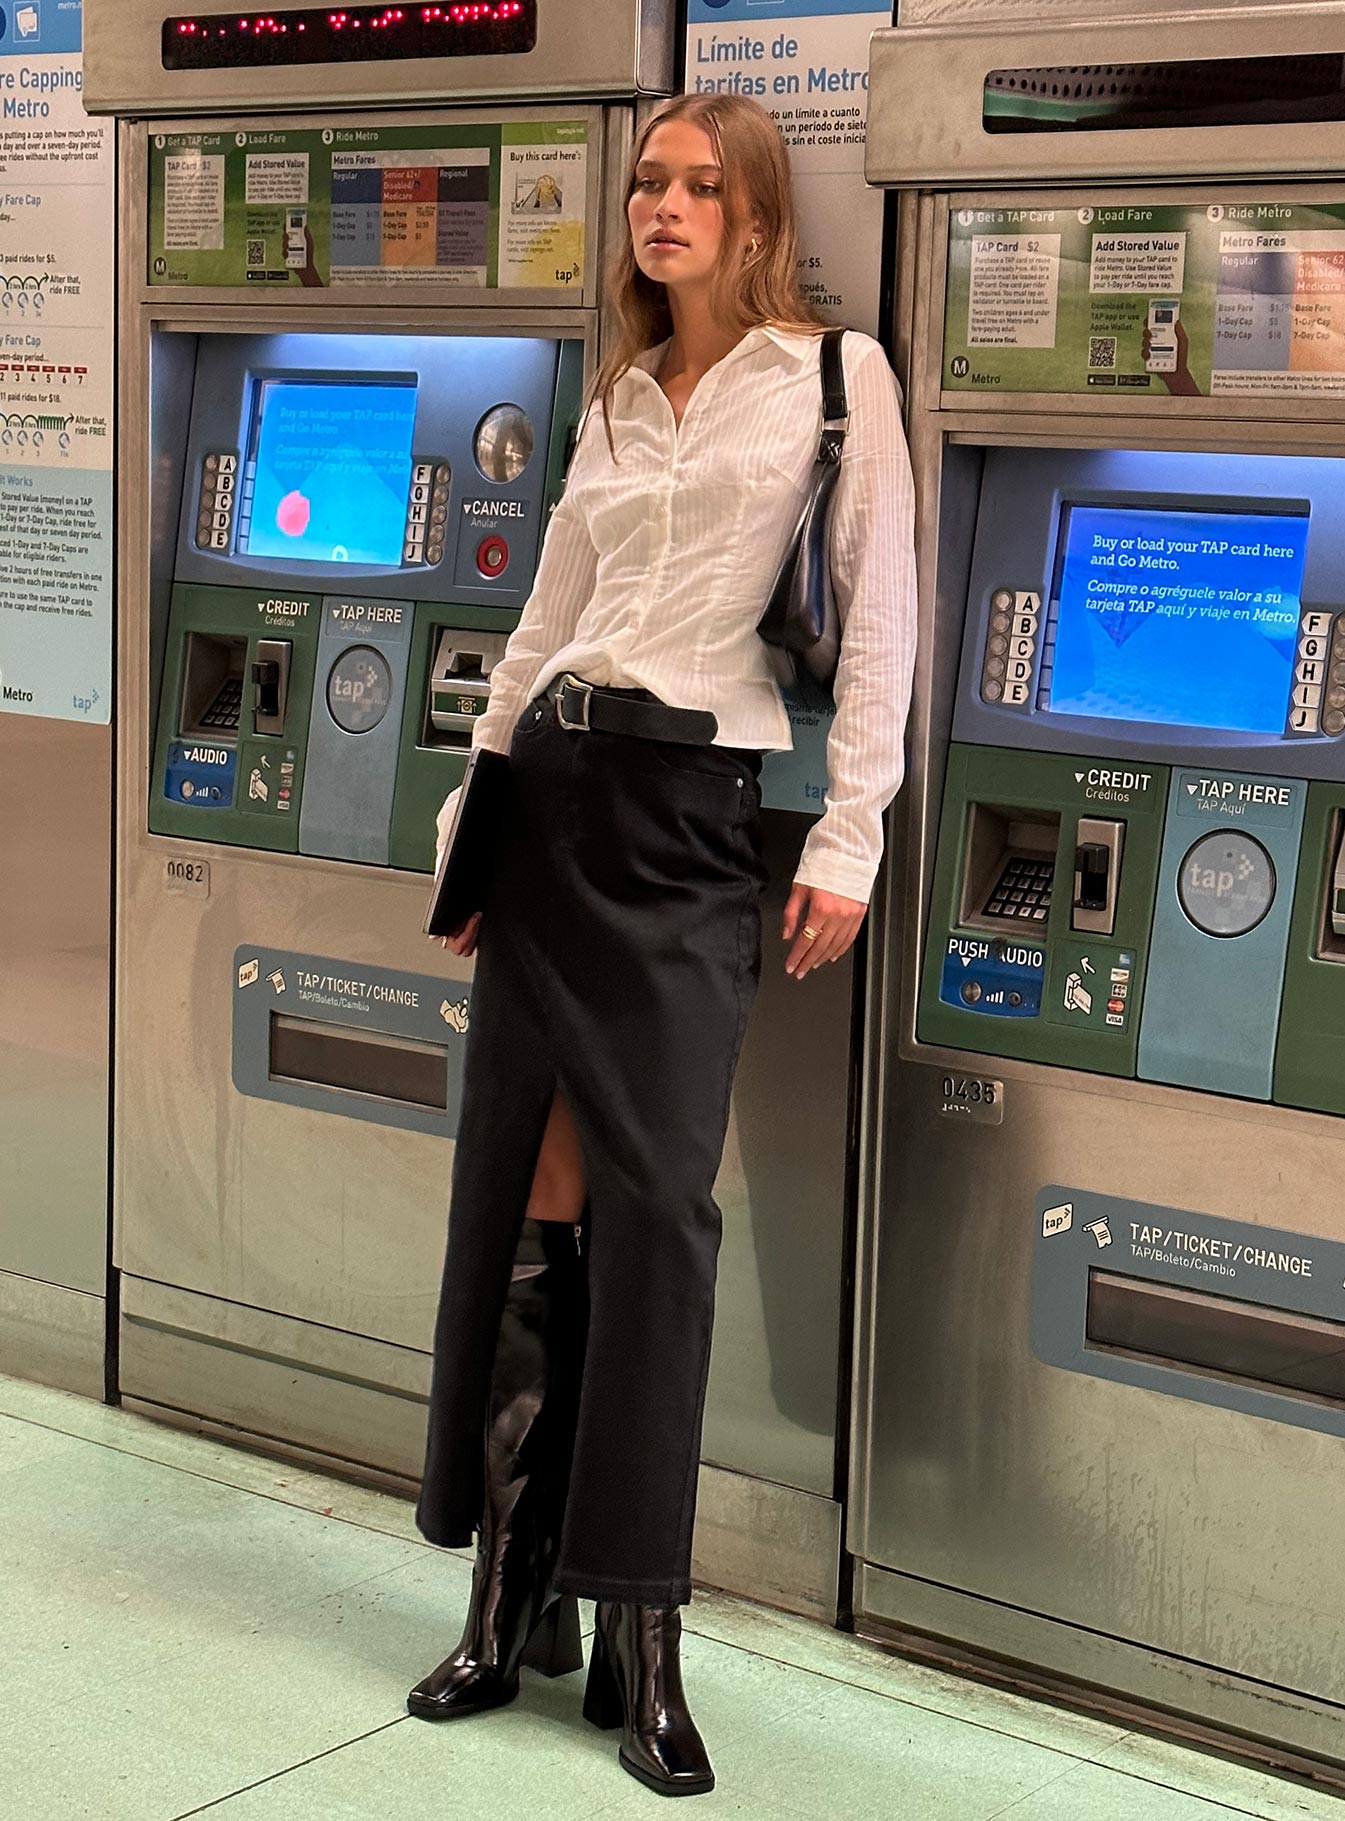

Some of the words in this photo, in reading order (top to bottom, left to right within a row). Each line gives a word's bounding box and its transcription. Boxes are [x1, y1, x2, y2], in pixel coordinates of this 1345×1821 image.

[697, 35, 764, 63] Límite
[771, 34, 798, 59] de
[19, 67, 82, 92] Capping
[696, 72, 766, 95] tarifas
[773, 75, 799, 95] en
[4, 98, 49, 118] Metro
[783, 111, 793, 119] un
[831, 108, 860, 117] cuanto
[786, 124, 796, 132] un
[834, 121, 845, 130] de
[168, 138, 180, 146] Get
[188, 137, 201, 145] TAP
[203, 136, 220, 145] Card
[249, 135, 267, 144] Load
[269, 134, 286, 143] Fare
[336, 132, 353, 141] Ride
[355, 131, 378, 141] Metro
[792, 135, 805, 145] sin
[807, 135, 815, 144] el
[818, 135, 841, 144] coste
[9, 152, 24, 161] rides
[26, 153, 48, 161] without
[50, 152, 59, 160] the
[61, 152, 84, 162] upfront
[248, 160, 261, 169] Add
[263, 159, 285, 169] Stored
[286, 159, 305, 168] Value
[334, 155, 354, 165] Metro
[355, 155, 375, 164] Fares
[510, 152, 523, 163] Buy
[526, 151, 539, 161] this
[541, 151, 557, 161] card
[333, 172, 358, 181] Regular
[5, 195, 23, 205] Fare
[26, 194, 41, 208] Cap
[977, 212, 995, 222] Get
[1007, 212, 1027, 222] TAP
[1030, 211, 1054, 222] Card
[1098, 209, 1124, 221] Load
[1128, 209, 1152, 220] Fare
[1228, 207, 1254, 218] Ride
[1257, 206, 1292, 218] Metro
[976, 242, 994, 252] TAP
[996, 241, 1018, 252] Card
[1027, 241, 1039, 252] $2
[1096, 241, 1114, 251] Add
[1118, 240, 1150, 251] Stored
[1151, 240, 1179, 250] Value
[1223, 237, 1253, 247] Metro
[1256, 235, 1286, 247] Fares
[5, 255, 18, 263] paid
[36, 254, 45, 262] for
[47, 254, 56, 263] $5.
[809, 257, 822, 268] $5.
[1222, 256, 1258, 266] Regular
[50, 275, 65, 283] After
[67, 276, 80, 284] that,
[555, 269, 572, 284] tap
[49, 286, 62, 294] ride
[64, 286, 80, 294] FREE
[809, 295, 842, 305] GRATIS
[16, 373, 20, 382] 3
[31, 373, 35, 382] 4
[47, 374, 51, 383] 5
[62, 375, 67, 384] 6
[78, 375, 83, 384] 7
[971, 374, 1000, 384] Metro
[224, 458, 231, 472] A
[417, 467, 425, 480] F
[223, 477, 230, 489] B
[415, 487, 423, 500] G
[221, 495, 227, 509] C
[472, 501, 524, 517] CANCEL
[412, 506, 420, 517] H
[220, 514, 226, 527] D
[470, 518, 498, 528] Anular
[217, 533, 224, 545] E
[413, 526, 416, 539] I
[408, 545, 415, 558] J
[1093, 535, 1118, 550] Buy
[1121, 539, 1134, 549] or
[1137, 538, 1164, 551] load
[1167, 541, 1199, 554] your
[1201, 541, 1228, 554] TAP
[1231, 544, 1260, 556] card
[1263, 544, 1294, 558] here
[1091, 555, 1115, 566] and
[1118, 554, 1136, 567] Go
[1139, 557, 1180, 571] Metro.
[1088, 580, 1137, 595] Compre
[1140, 585, 1149, 595] o
[1151, 585, 1215, 600] agréguele
[1219, 589, 1252, 602] valor
[1254, 593, 1262, 603] a
[1265, 593, 1281, 604] su
[266, 600, 310, 616] CREDIT
[1023, 595, 1033, 611] A
[341, 604, 364, 620] TAP
[368, 607, 402, 623] HERE
[1085, 598, 1125, 613] tarjeta
[1128, 600, 1155, 614] TAP
[1156, 603, 1186, 618] aquí
[1186, 607, 1197, 618] y
[1233, 609, 1249, 620] en
[1252, 608, 1296, 624] Metro.
[265, 615, 295, 627] Créditos
[1020, 618, 1031, 634] B
[1309, 616, 1320, 632] F
[1018, 640, 1028, 656] C
[1306, 640, 1317, 656] G
[1015, 663, 1025, 678] D
[1302, 663, 1315, 680] H
[3, 686, 32, 702] Metro
[335, 675, 364, 703] tap
[1012, 686, 1022, 701] E
[1303, 687, 1308, 704] I
[73, 695, 91, 713] tap
[792, 717, 820, 726] recibir
[1296, 711, 1306, 727] J
[191, 748, 227, 765] AUDIO
[1088, 768, 1151, 791] CREDIT
[1085, 788, 1130, 803] Créditos
[1199, 780, 1234, 799] TAP
[1239, 784, 1291, 806] HERE
[1197, 798, 1218, 811] TAP
[1220, 801, 1246, 815] Aquí
[167, 861, 203, 882] 0082
[1190, 862, 1234, 897] tap
[948, 938, 989, 959] PUSH
[240, 969, 253, 982] tap
[297, 971, 419, 1008] TAP/TICKET/CHANGE
[943, 1077, 995, 1104] 0435
[1045, 1215, 1063, 1230] tap
[1129, 1222, 1313, 1278] TAP/TICKET/CHANGE
[1130, 1244, 1236, 1277] TAP/Boleto/Cambio
